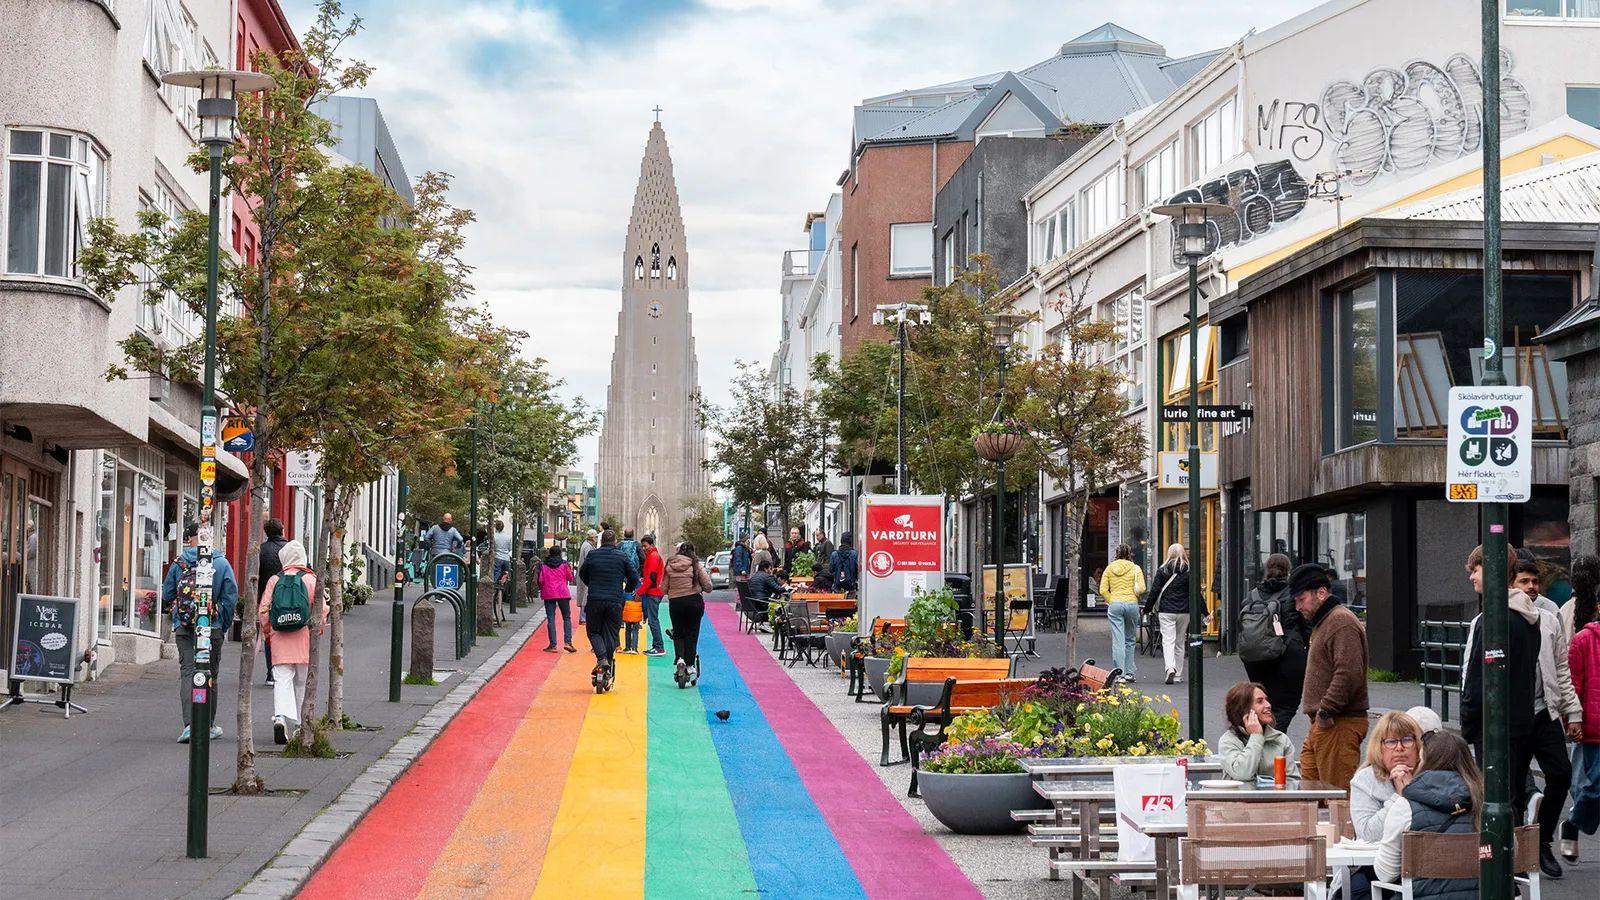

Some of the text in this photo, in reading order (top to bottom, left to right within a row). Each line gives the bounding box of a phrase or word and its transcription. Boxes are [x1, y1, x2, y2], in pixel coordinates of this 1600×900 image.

[1257, 98, 1324, 162] MFS
[1197, 409, 1217, 418] fine
[1220, 409, 1236, 418] art
[871, 530, 937, 540] VARÐTURN
[443, 566, 452, 578] P
[40, 612, 58, 622] ICE
